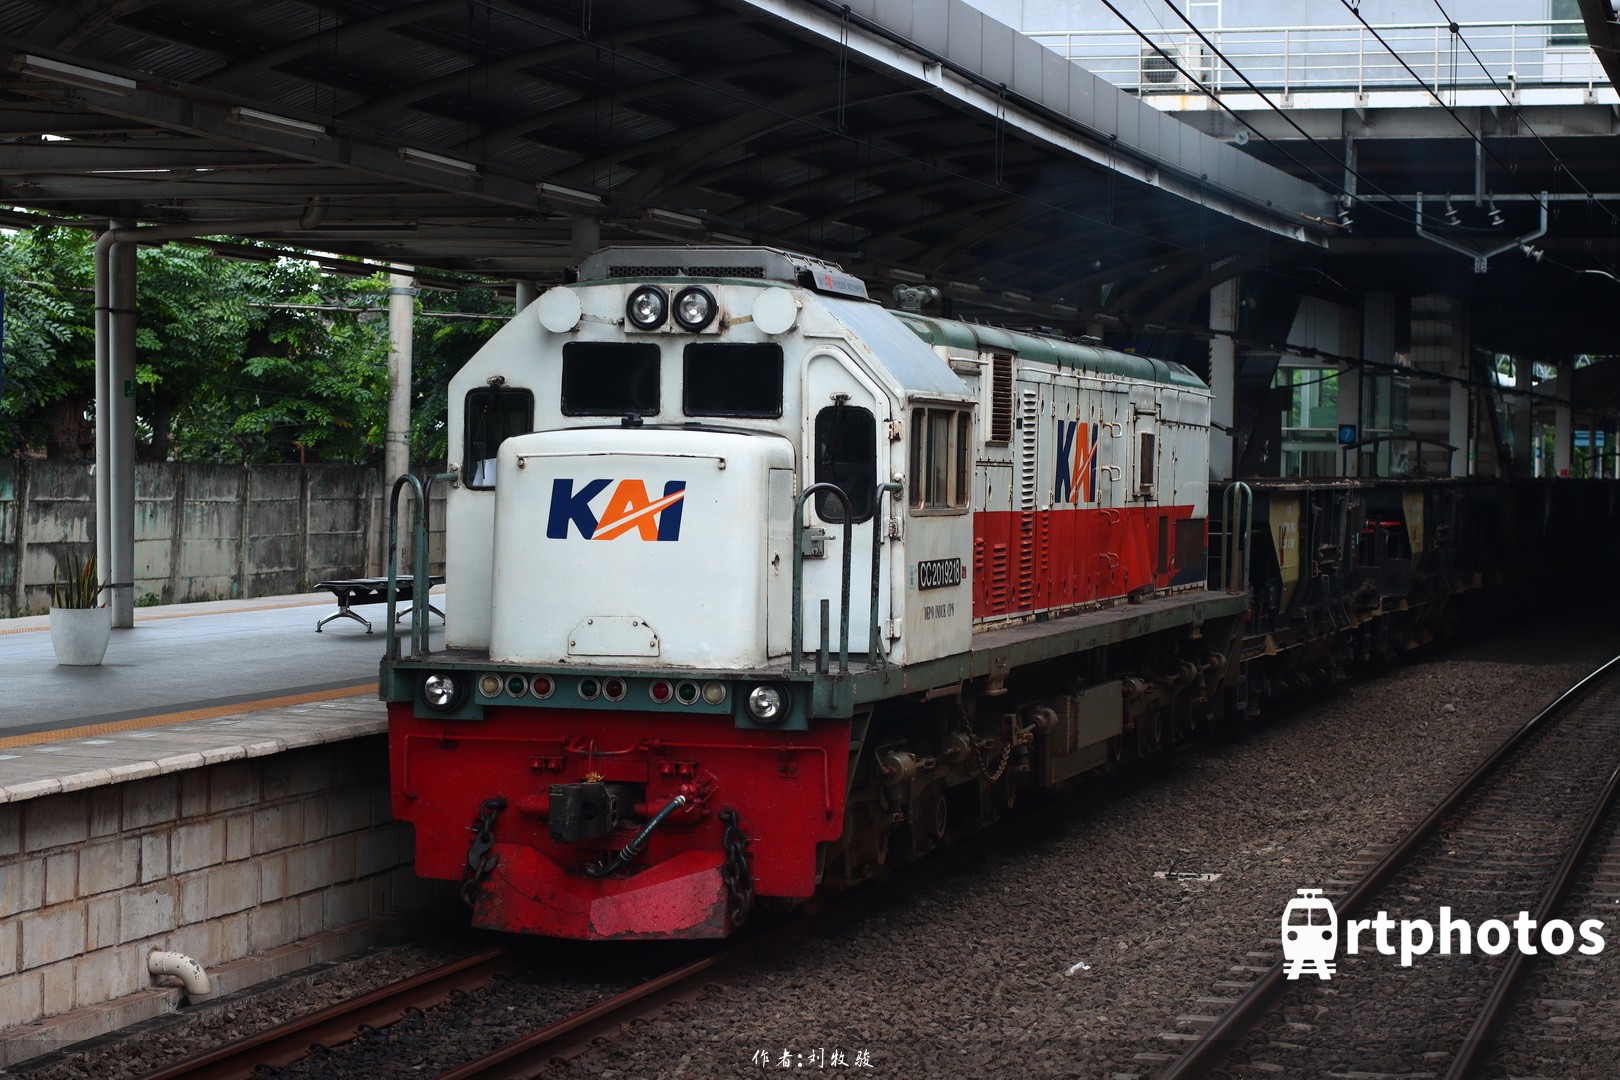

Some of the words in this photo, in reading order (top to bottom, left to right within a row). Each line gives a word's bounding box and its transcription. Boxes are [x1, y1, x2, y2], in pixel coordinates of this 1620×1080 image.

[1055, 419, 1098, 503] KAI
[1344, 429, 1351, 439] 7
[546, 478, 686, 541] KAI
